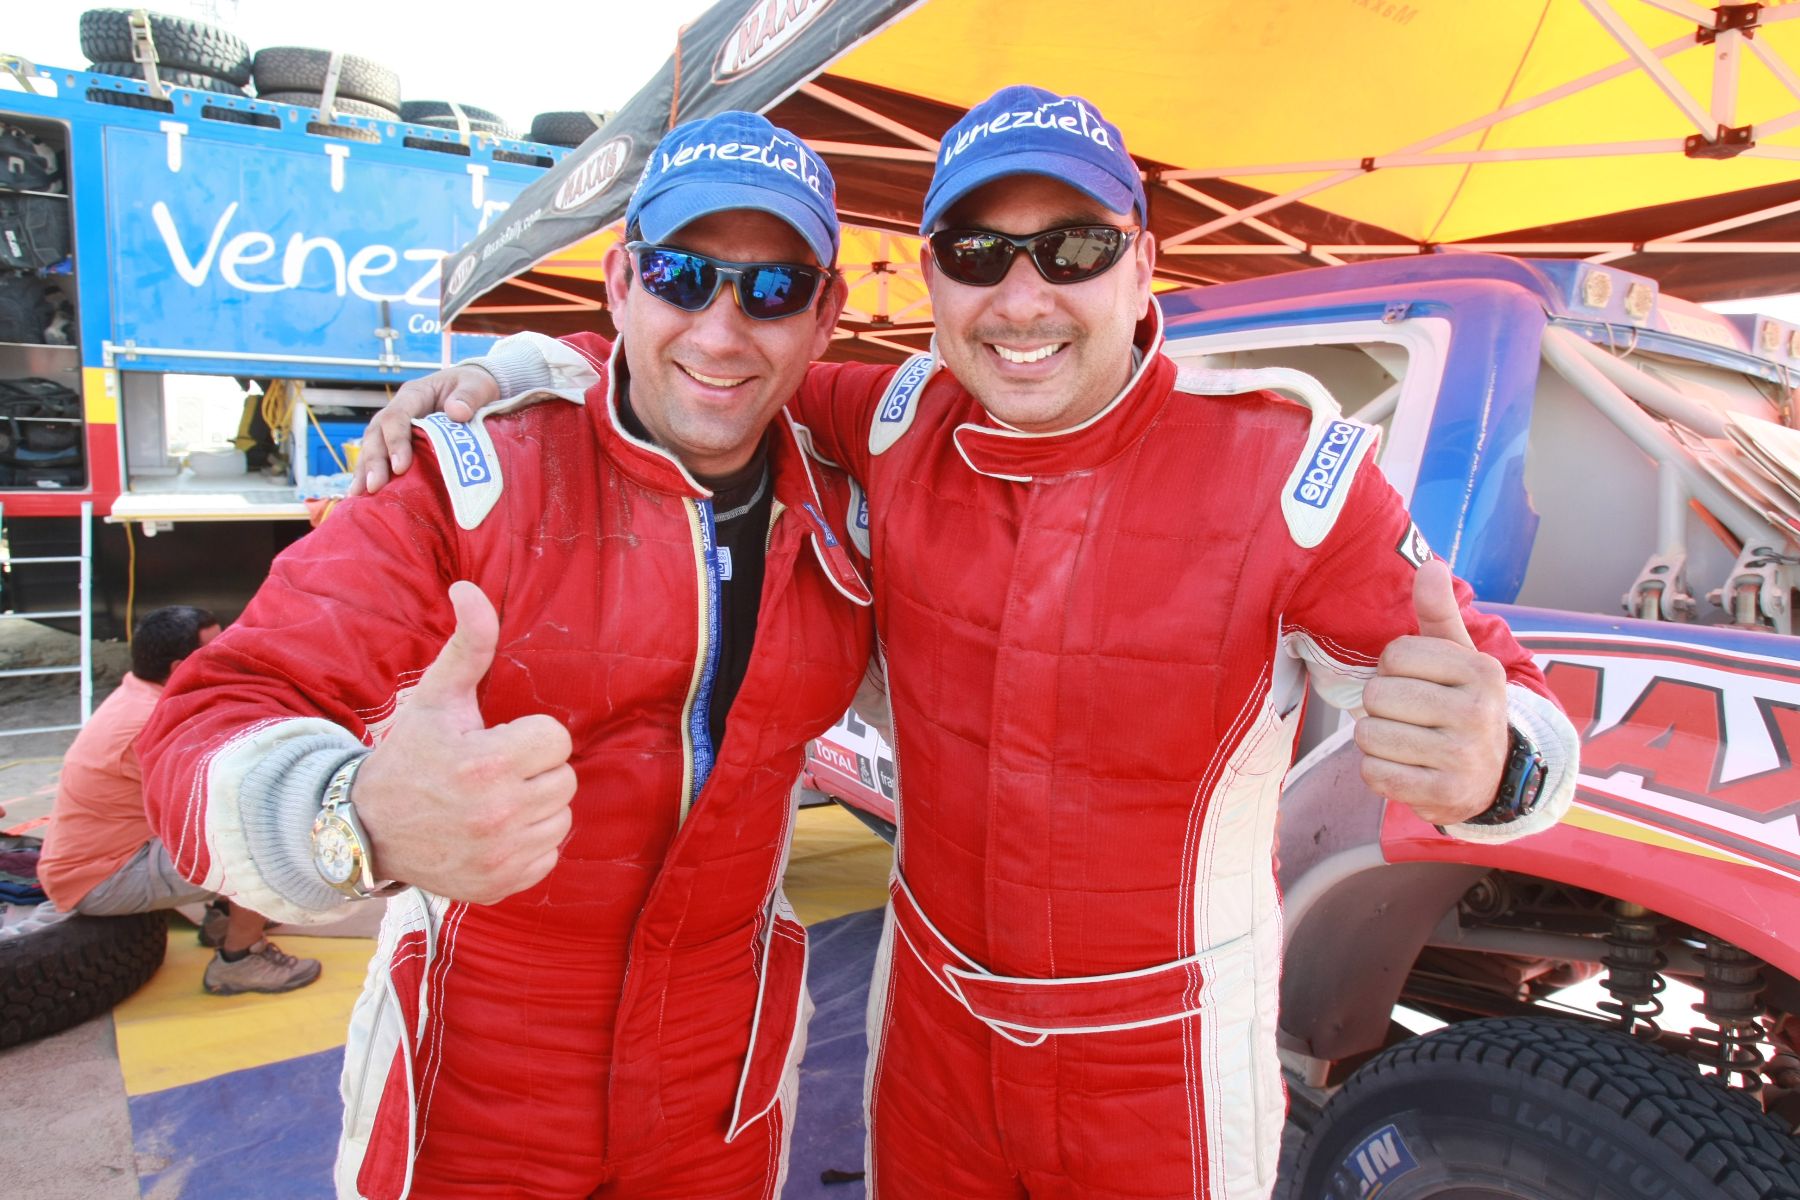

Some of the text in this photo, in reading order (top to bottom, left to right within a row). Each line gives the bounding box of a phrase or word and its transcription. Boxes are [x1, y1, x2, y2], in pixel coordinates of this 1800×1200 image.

[944, 100, 1114, 166] Venezuela
[661, 142, 824, 199] Venezuela
[884, 359, 932, 419] sparco
[432, 416, 486, 482] sparco
[1301, 423, 1358, 503] sparco
[815, 738, 858, 774] TOTAL
